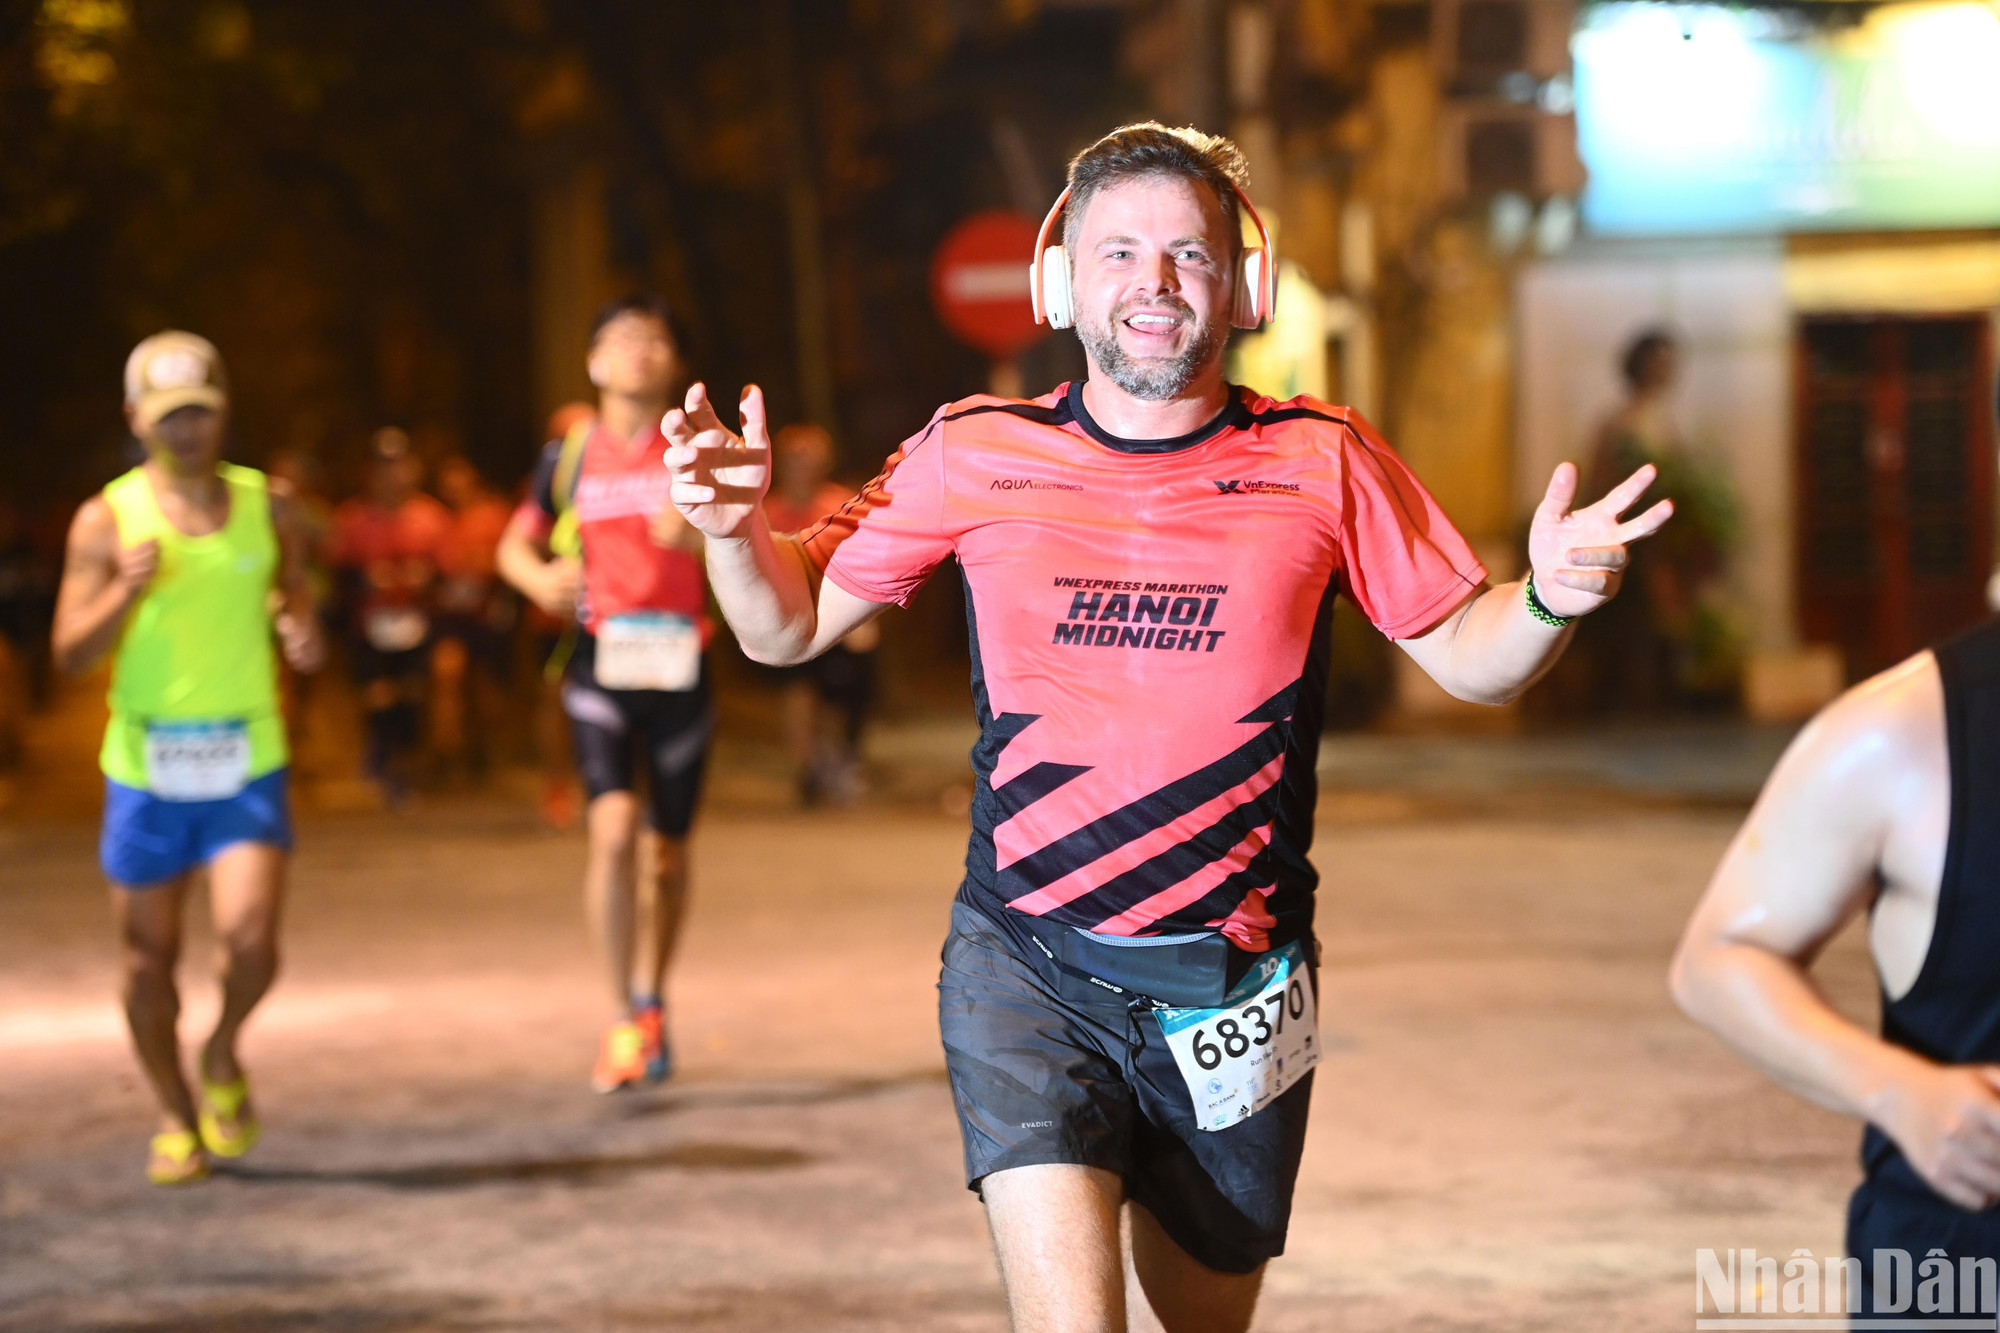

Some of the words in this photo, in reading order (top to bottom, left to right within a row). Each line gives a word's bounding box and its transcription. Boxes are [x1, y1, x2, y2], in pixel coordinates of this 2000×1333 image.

[990, 479, 1033, 490] AQUA
[1034, 482, 1084, 491] ELECTRONICS
[1243, 480, 1300, 491] VnExpress
[1053, 577, 1142, 591] VNEXPRESS
[1144, 582, 1229, 595] MARATHON
[1067, 591, 1219, 627] HANOI
[1052, 622, 1226, 652] MIDNIGHT
[1192, 979, 1304, 1070] 68370
[1250, 1057, 1263, 1067] Run
[1021, 1120, 1053, 1129] EVADICT
